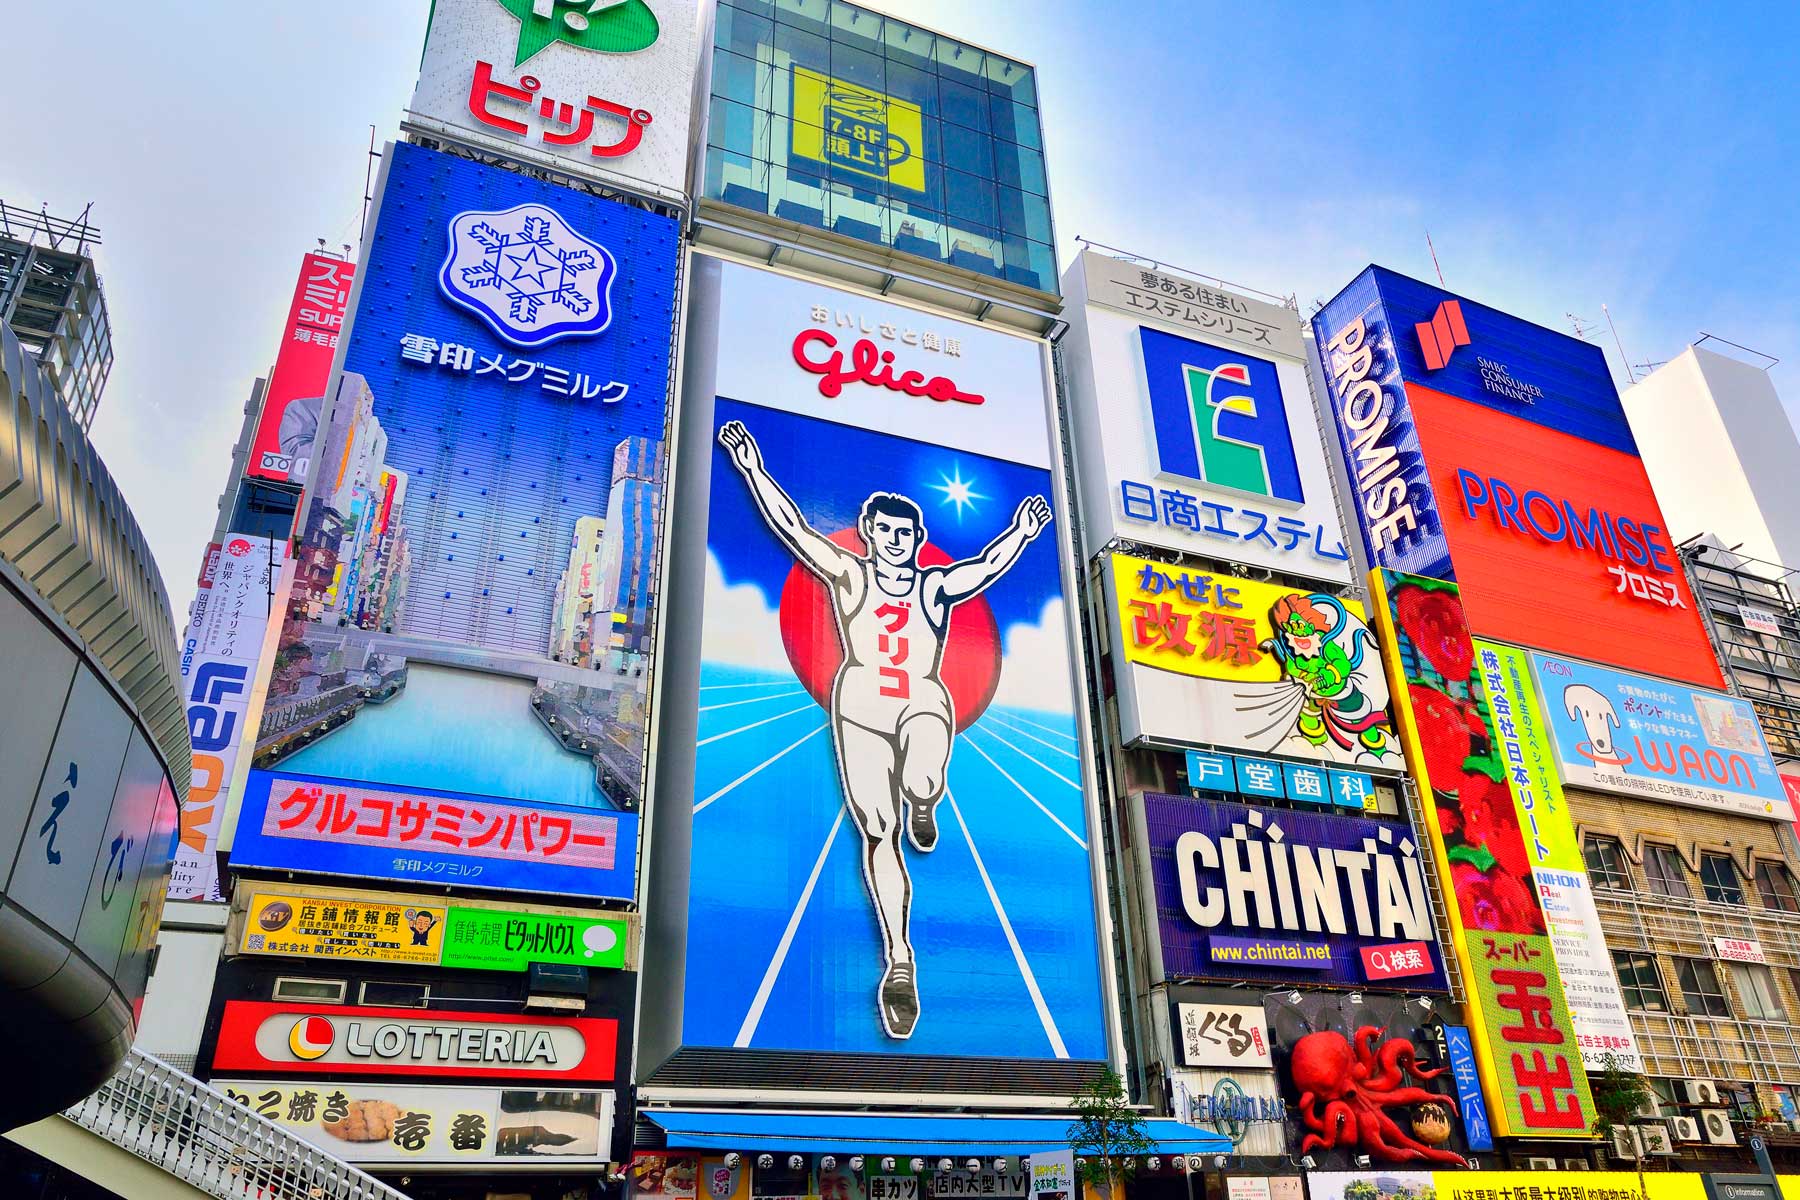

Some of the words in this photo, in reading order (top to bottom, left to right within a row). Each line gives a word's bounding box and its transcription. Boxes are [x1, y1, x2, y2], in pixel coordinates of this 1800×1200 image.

[468, 60, 653, 158] ピップ
[831, 117, 881, 145] 7-8F
[1140, 271, 1248, 314] 夢ある住まい
[811, 304, 961, 357] おいしさと健康
[1125, 291, 1272, 345] エステムシリーズ
[400, 332, 629, 403] 雪印メグミルク
[1477, 356, 1508, 375] SMBC
[1481, 369, 1545, 398] CONSUMER
[1484, 380, 1536, 406] FINANCE
[1328, 318, 1416, 551] PROMISE
[1120, 480, 1349, 561] 日商エステム
[1457, 468, 1674, 573] PROMISE
[1137, 564, 1243, 609] かぜに
[1608, 565, 1687, 609] プロミス
[193, 593, 209, 628] SEIKO
[222, 564, 254, 657] ジャパンクオリティの
[873, 601, 912, 699] グリコ
[1128, 598, 1264, 667] 改源
[1624, 697, 1663, 719] ポイント
[1480, 649, 1550, 862] 株式会社日本リート
[1634, 736, 1757, 790] WAON
[1196, 756, 1367, 807] 戸堂歯科
[277, 787, 606, 857] グルコサミンパワー
[392, 857, 484, 878] 雪印メグミルク
[1176, 809, 1434, 941] CHINTAI
[1536, 872, 1581, 888] NIHON
[300, 905, 400, 926] 店舗情報館
[268, 941, 309, 952] 株式会社
[314, 945, 377, 957] 関西インベスト
[454, 920, 502, 946] 賃貸・売買
[505, 919, 575, 956] ピタットハウス
[1483, 938, 1541, 963] スーパー
[1390, 949, 1424, 970] 検索
[346, 1022, 557, 1064] LOTTERIA
[1198, 1011, 1253, 1058] くくる
[1435, 1025, 1447, 1060] 2F
[1491, 969, 1585, 1130] 玉出
[393, 1111, 488, 1152] 壱番
[872, 1176, 917, 1200] 串カツ
[935, 1174, 1023, 1194] 店内大型TV
